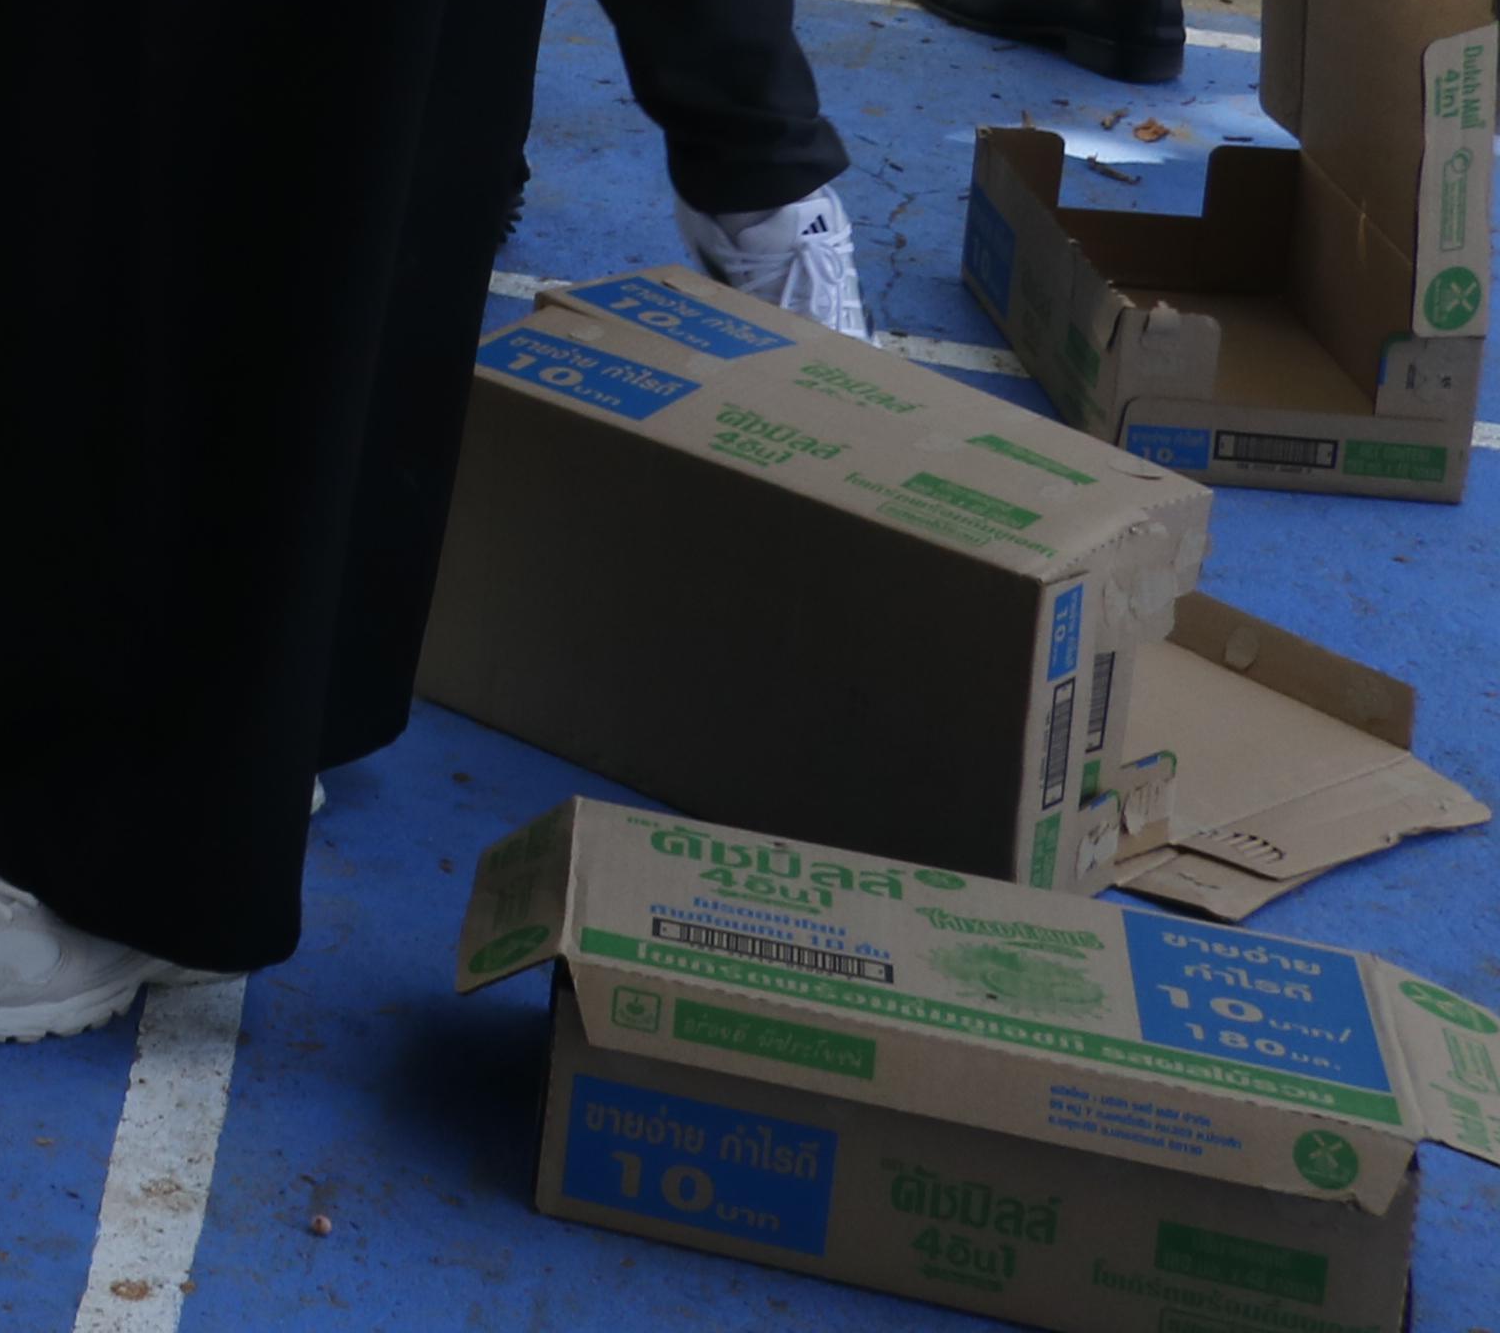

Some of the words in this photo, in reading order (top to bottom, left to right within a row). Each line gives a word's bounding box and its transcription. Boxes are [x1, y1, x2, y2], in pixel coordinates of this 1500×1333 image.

[1463, 45, 1485, 95] Dutch
[1460, 98, 1486, 129] Mill
[509, 337, 599, 371] ขายง่าย
[600, 364, 684, 398] กำไรดี
[650, 825, 906, 901] ดัชมิลล์
[699, 865, 834, 908] 4อิน1
[1161, 932, 1322, 977] ขายง่าย
[1184, 963, 1315, 1004] กำไรดี
[1100, 1043, 1337, 1107] รสผลไม้รวม
[586, 1101, 706, 1155] ขายง่าย
[719, 1123, 821, 1182] กำไรดี
[890, 1165, 1064, 1246] ดัชมิลล์
[909, 1228, 1015, 1279] 4อิน1
